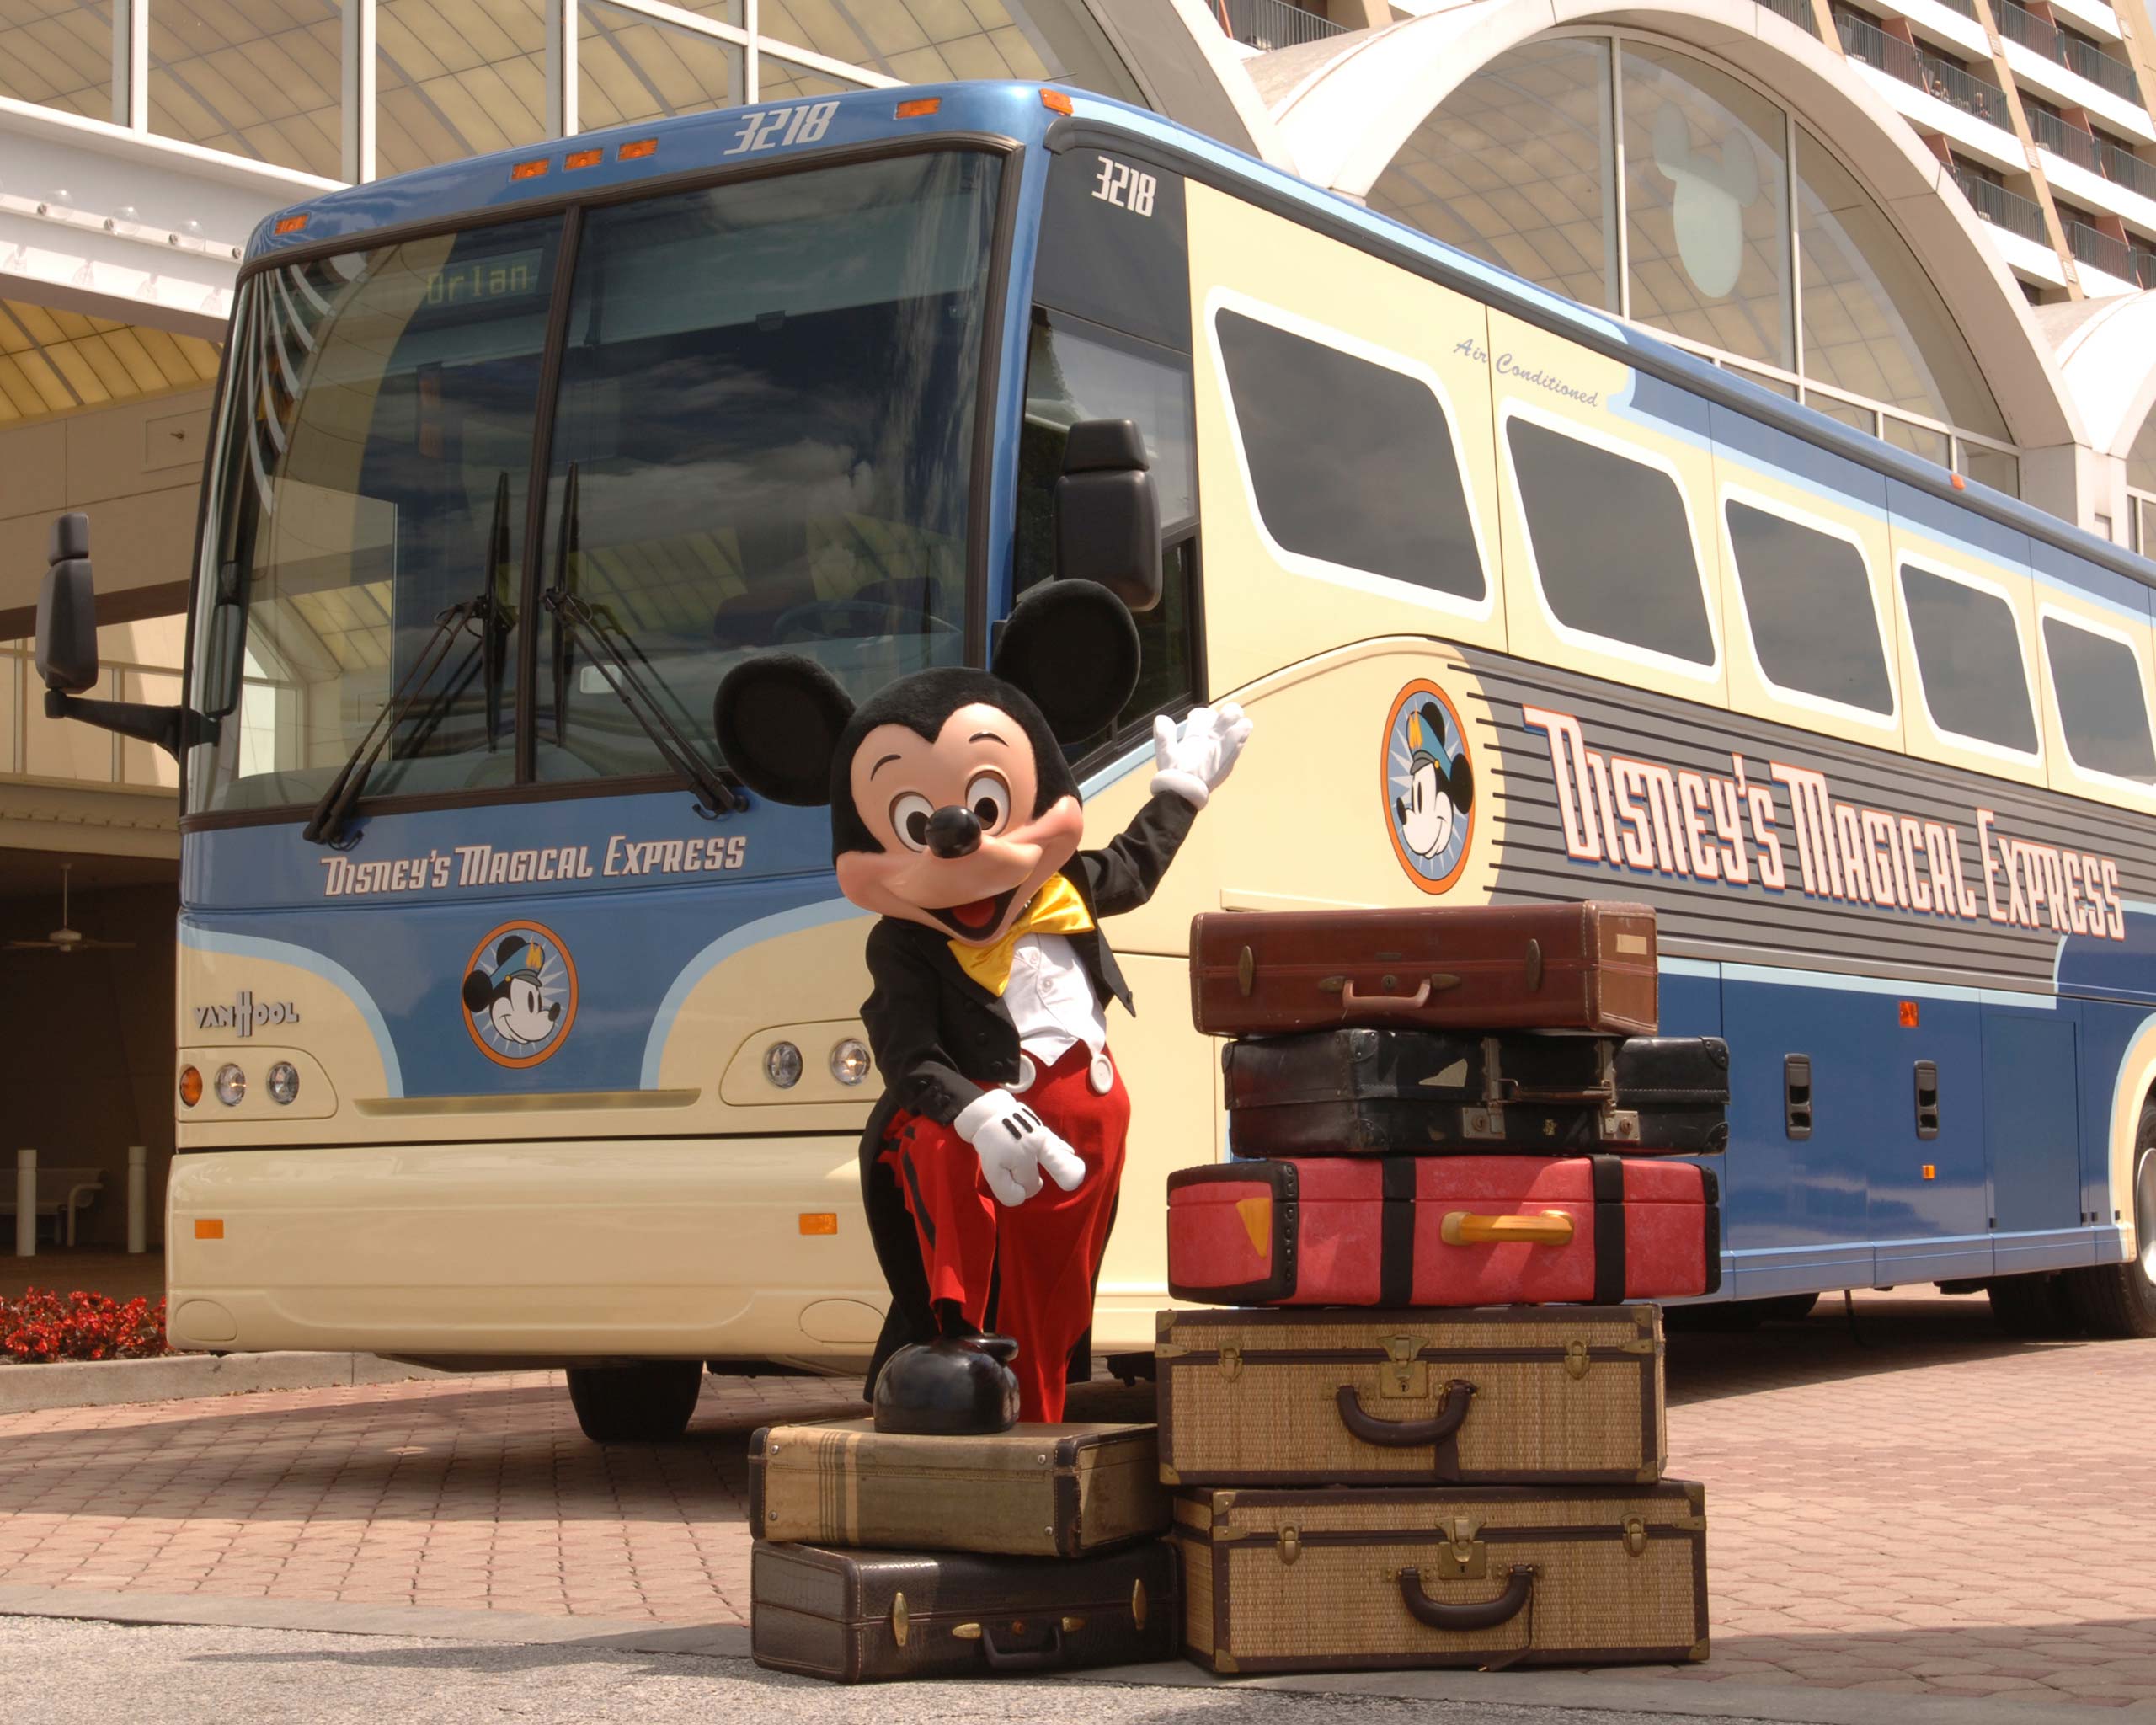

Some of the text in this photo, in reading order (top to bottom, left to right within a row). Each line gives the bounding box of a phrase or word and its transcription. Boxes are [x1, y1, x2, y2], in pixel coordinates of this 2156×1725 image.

[723, 101, 841, 155] 3218
[1091, 155, 1157, 217] 3218
[1453, 338, 1599, 407] Air Conditioned
[454, 844, 594, 886] MAGICAL
[602, 835, 747, 877] EXPRESS
[1769, 760, 1977, 921] MAGICAL
[1976, 808, 2126, 942] EXPRESS
